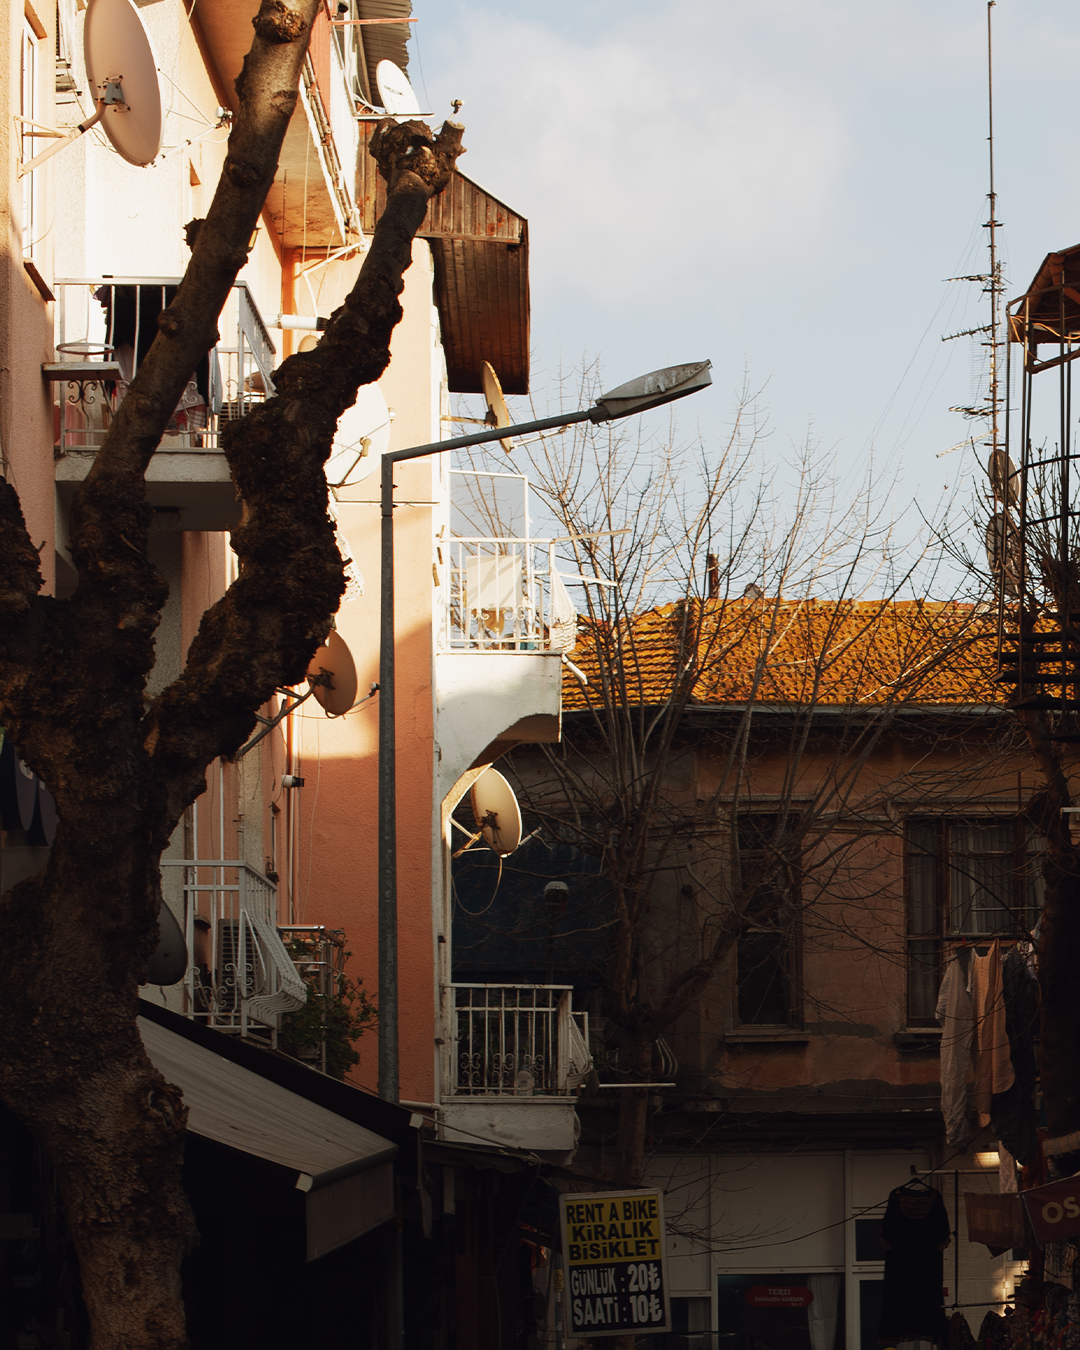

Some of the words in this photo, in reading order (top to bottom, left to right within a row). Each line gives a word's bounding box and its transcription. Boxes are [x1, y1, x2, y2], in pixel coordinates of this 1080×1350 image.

[566, 1203, 604, 1224] RENT
[609, 1202, 619, 1221] A
[623, 1199, 657, 1220] BIKE
[571, 1267, 617, 1296] GÜNLÜK
